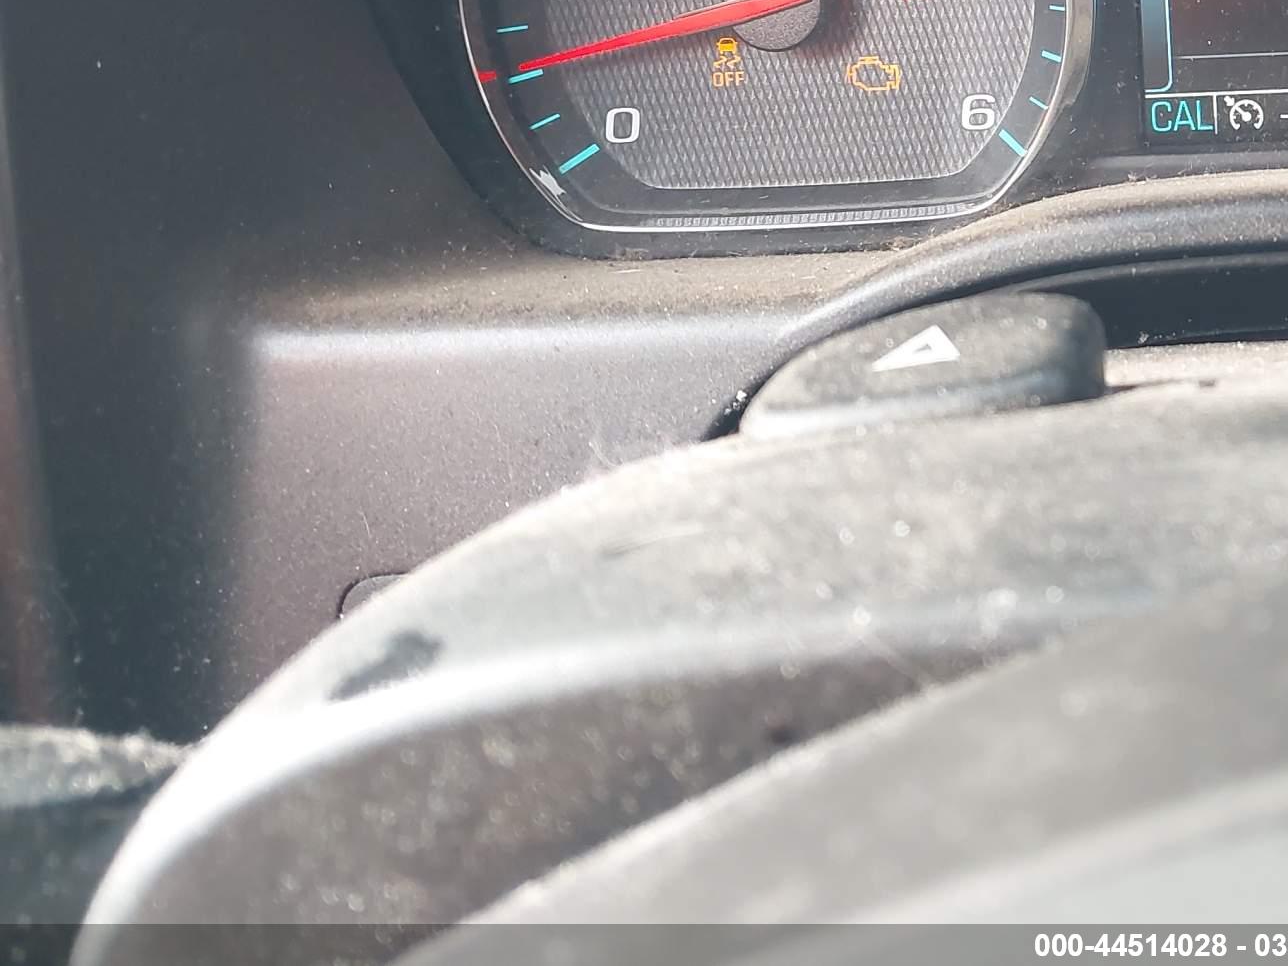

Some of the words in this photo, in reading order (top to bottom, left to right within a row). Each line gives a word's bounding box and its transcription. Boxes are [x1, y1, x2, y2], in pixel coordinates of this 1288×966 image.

[713, 71, 745, 87] OFF
[605, 107, 640, 144] 0
[961, 94, 996, 131] 6
[1151, 99, 1214, 132] CAL
